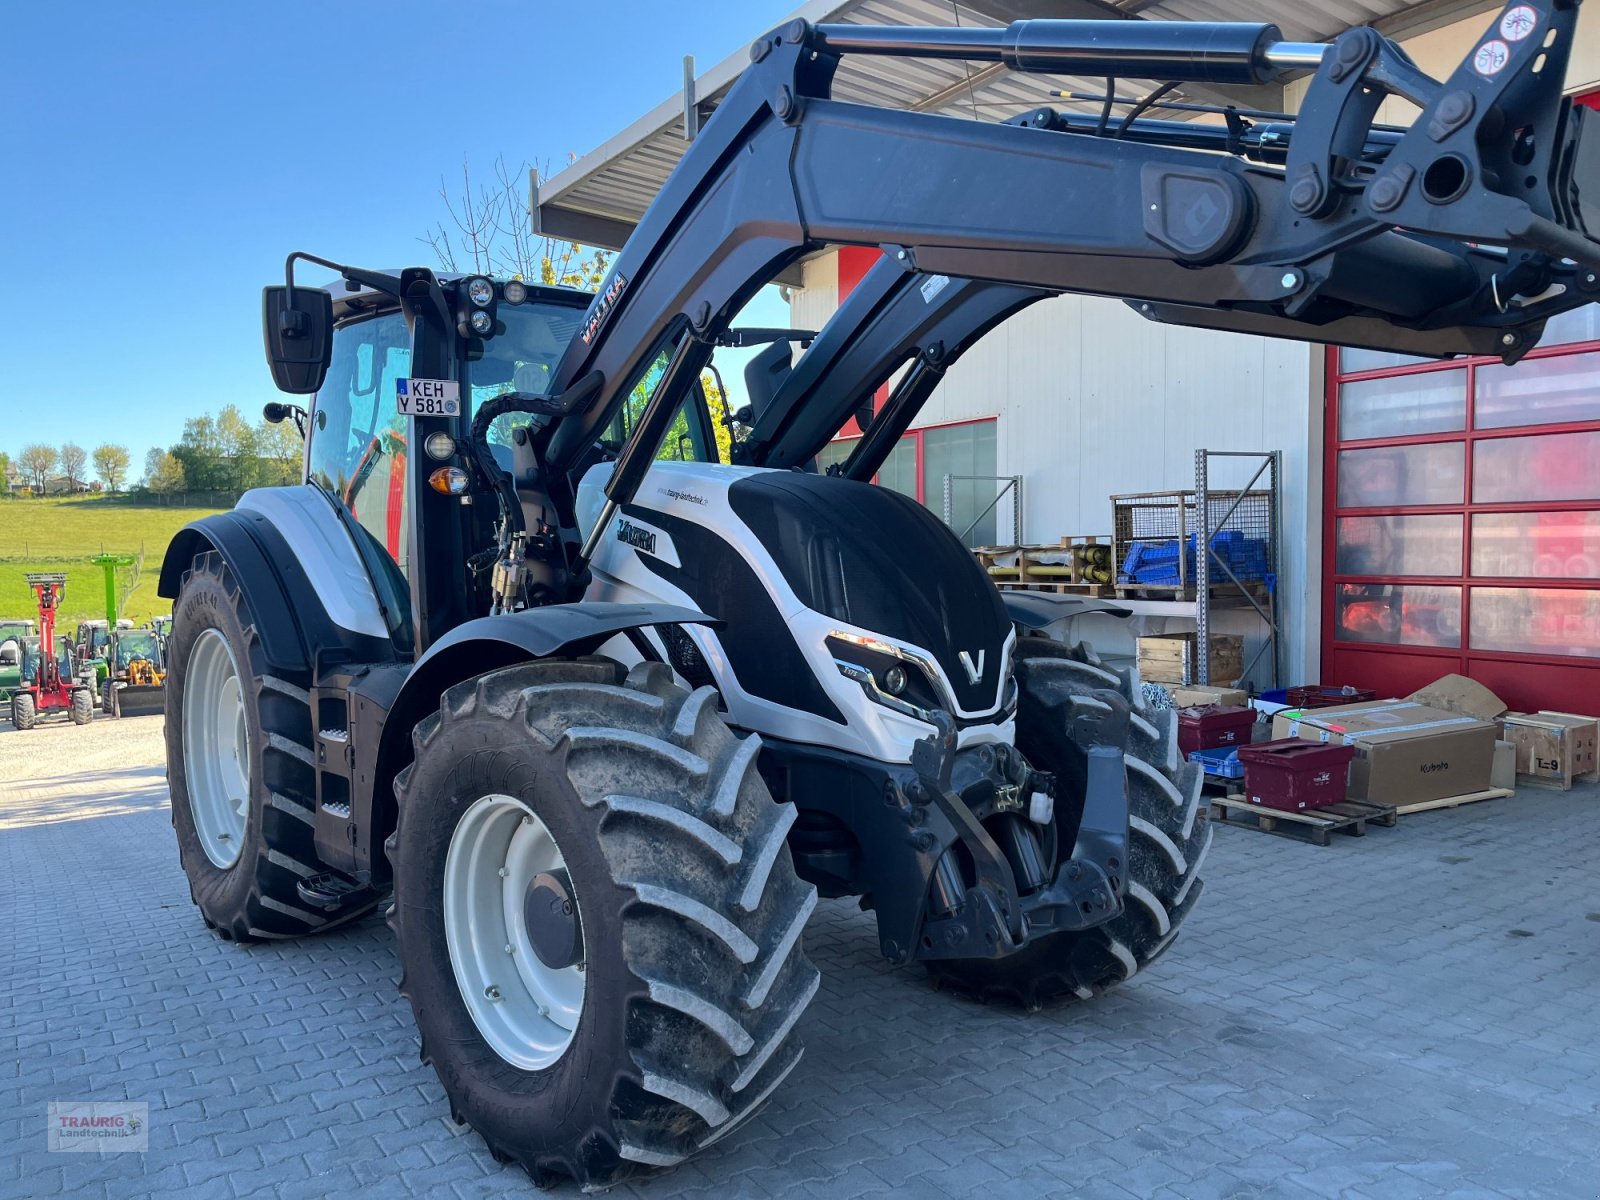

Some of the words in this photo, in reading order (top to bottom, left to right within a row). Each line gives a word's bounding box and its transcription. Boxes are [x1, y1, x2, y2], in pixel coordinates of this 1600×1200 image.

[580, 272, 626, 345] VALTRA
[412, 382, 443, 397] KEH
[400, 397, 409, 412] Y
[416, 398, 444, 413] 581
